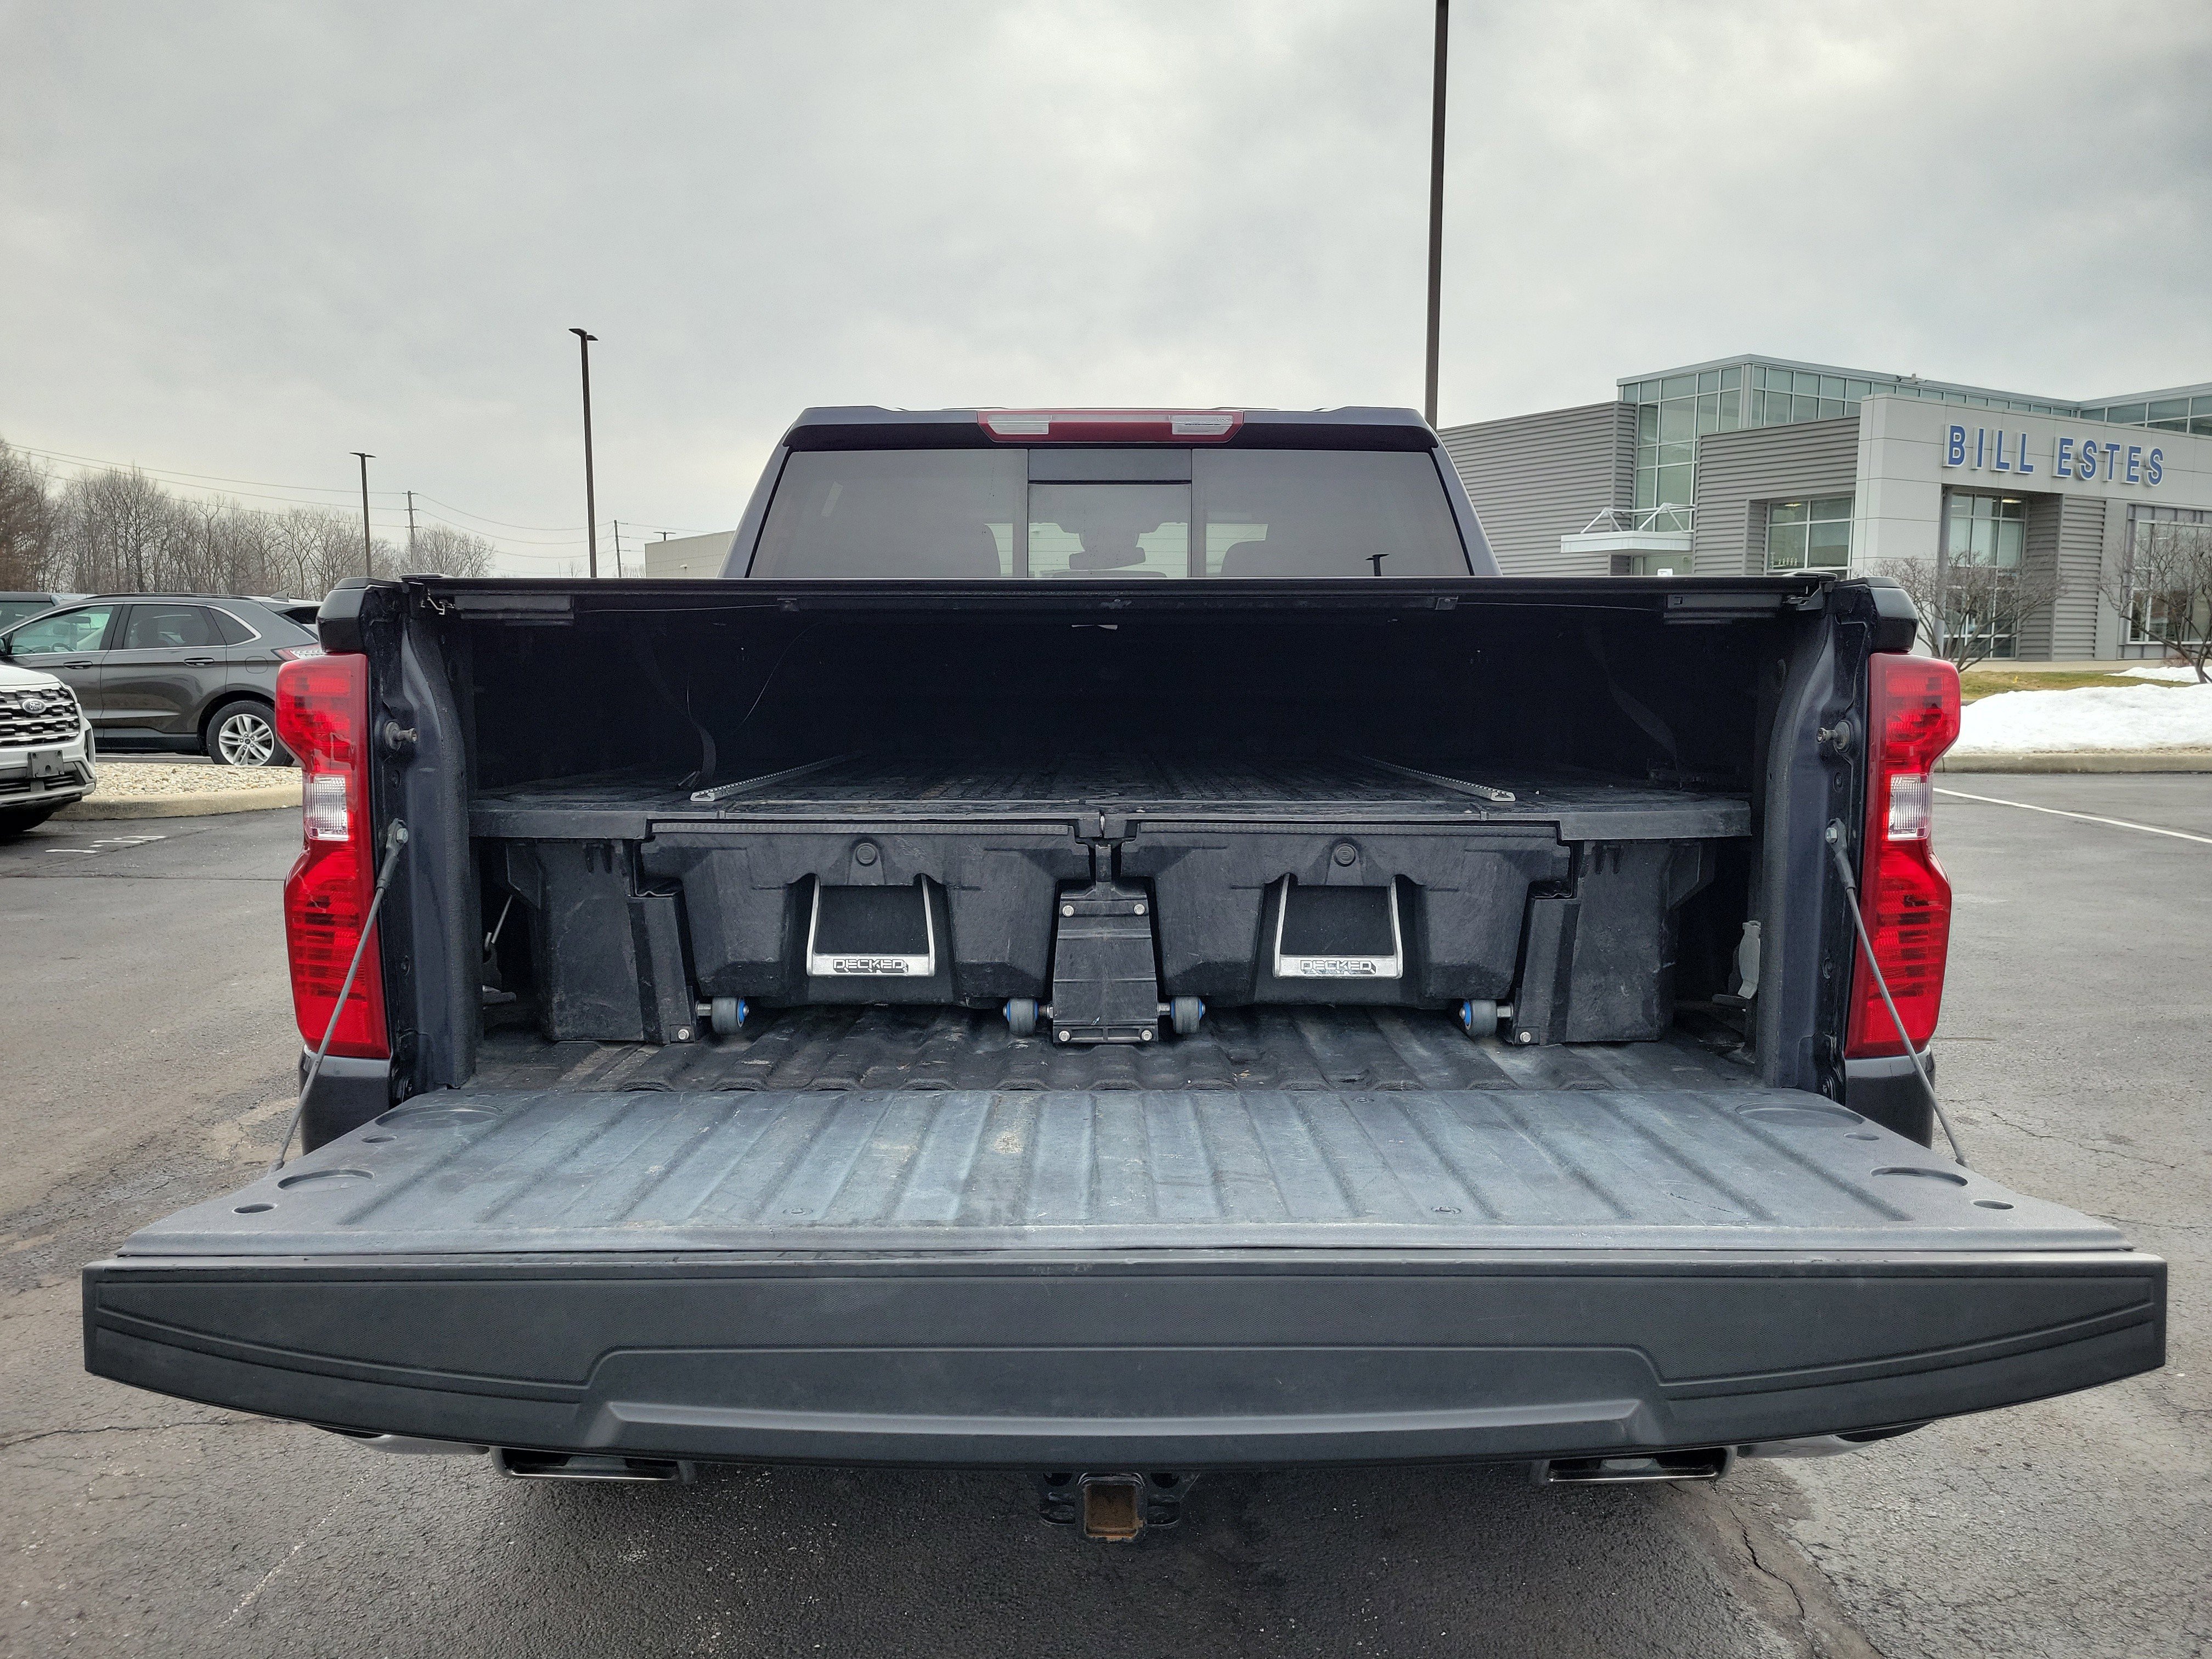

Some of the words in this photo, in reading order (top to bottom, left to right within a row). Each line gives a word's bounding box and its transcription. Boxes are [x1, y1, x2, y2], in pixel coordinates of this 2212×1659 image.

[1944, 424, 2034, 473] BILL
[2053, 437, 2164, 487] ESTES
[833, 959, 909, 973] DECKED
[1300, 960, 1376, 974] DECKED
